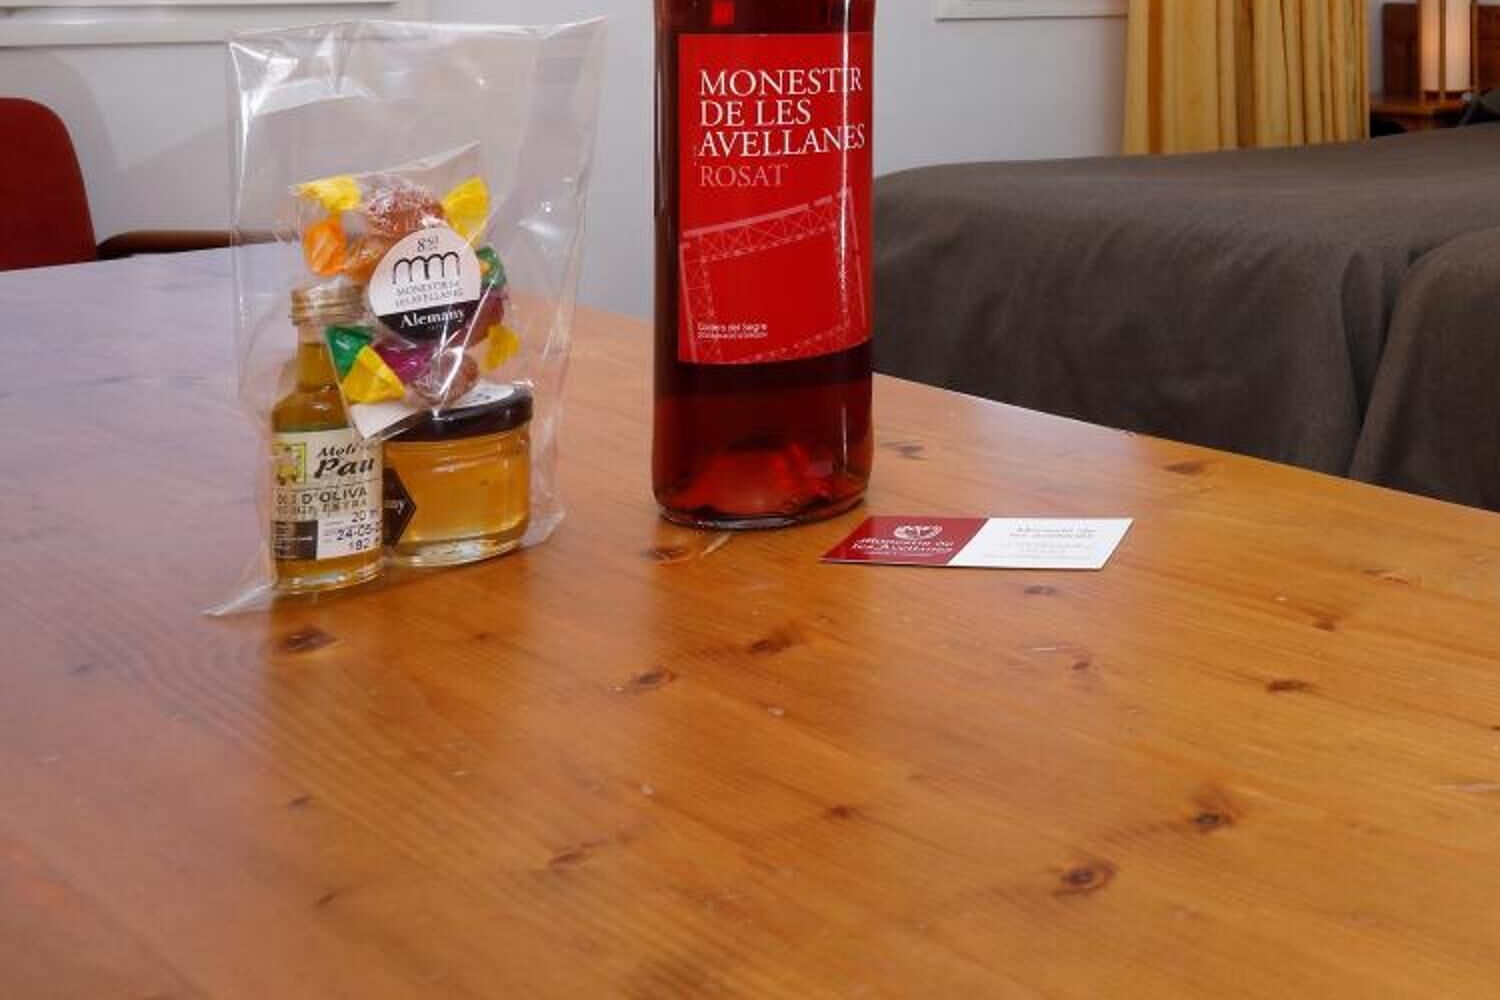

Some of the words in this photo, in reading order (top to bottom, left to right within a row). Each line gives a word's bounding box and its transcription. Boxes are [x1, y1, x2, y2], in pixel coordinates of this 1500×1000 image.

[700, 67, 863, 97] MONESTIR
[700, 100, 745, 127] DE
[755, 99, 812, 126] LES
[699, 123, 866, 158] AVELLANES
[700, 164, 789, 188] ROSAT
[400, 309, 464, 329] Alemany
[314, 458, 375, 479] Pau
[301, 486, 368, 505] D'OLIVA
